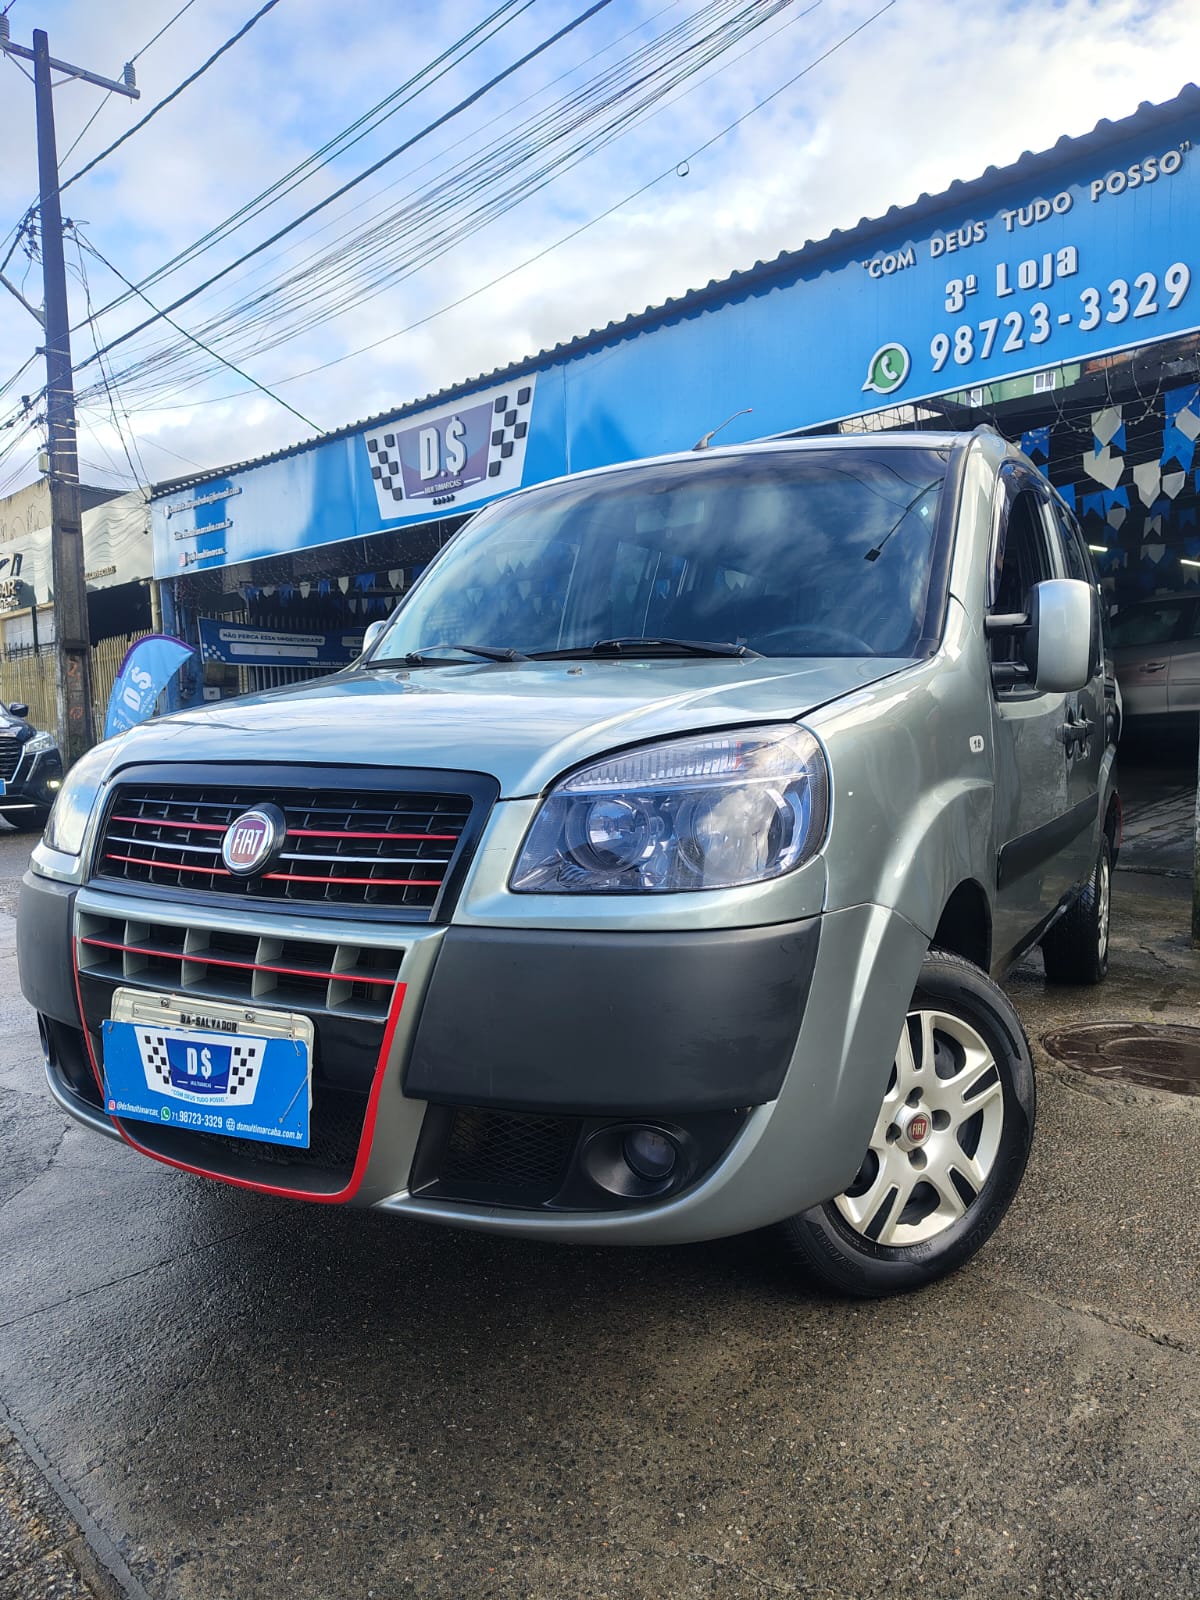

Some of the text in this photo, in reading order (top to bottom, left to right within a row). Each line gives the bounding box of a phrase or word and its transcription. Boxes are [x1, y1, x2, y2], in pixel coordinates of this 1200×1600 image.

[930, 221, 988, 259] DEUS
[1002, 191, 1074, 233] TUDO
[930, 261, 1192, 373] 98723-3329
[222, 631, 237, 639] NÃO
[231, 828, 264, 856] FIAT
[180, 1013, 238, 1033] BA-SALVADOR
[912, 1122, 925, 1136] FIAT
